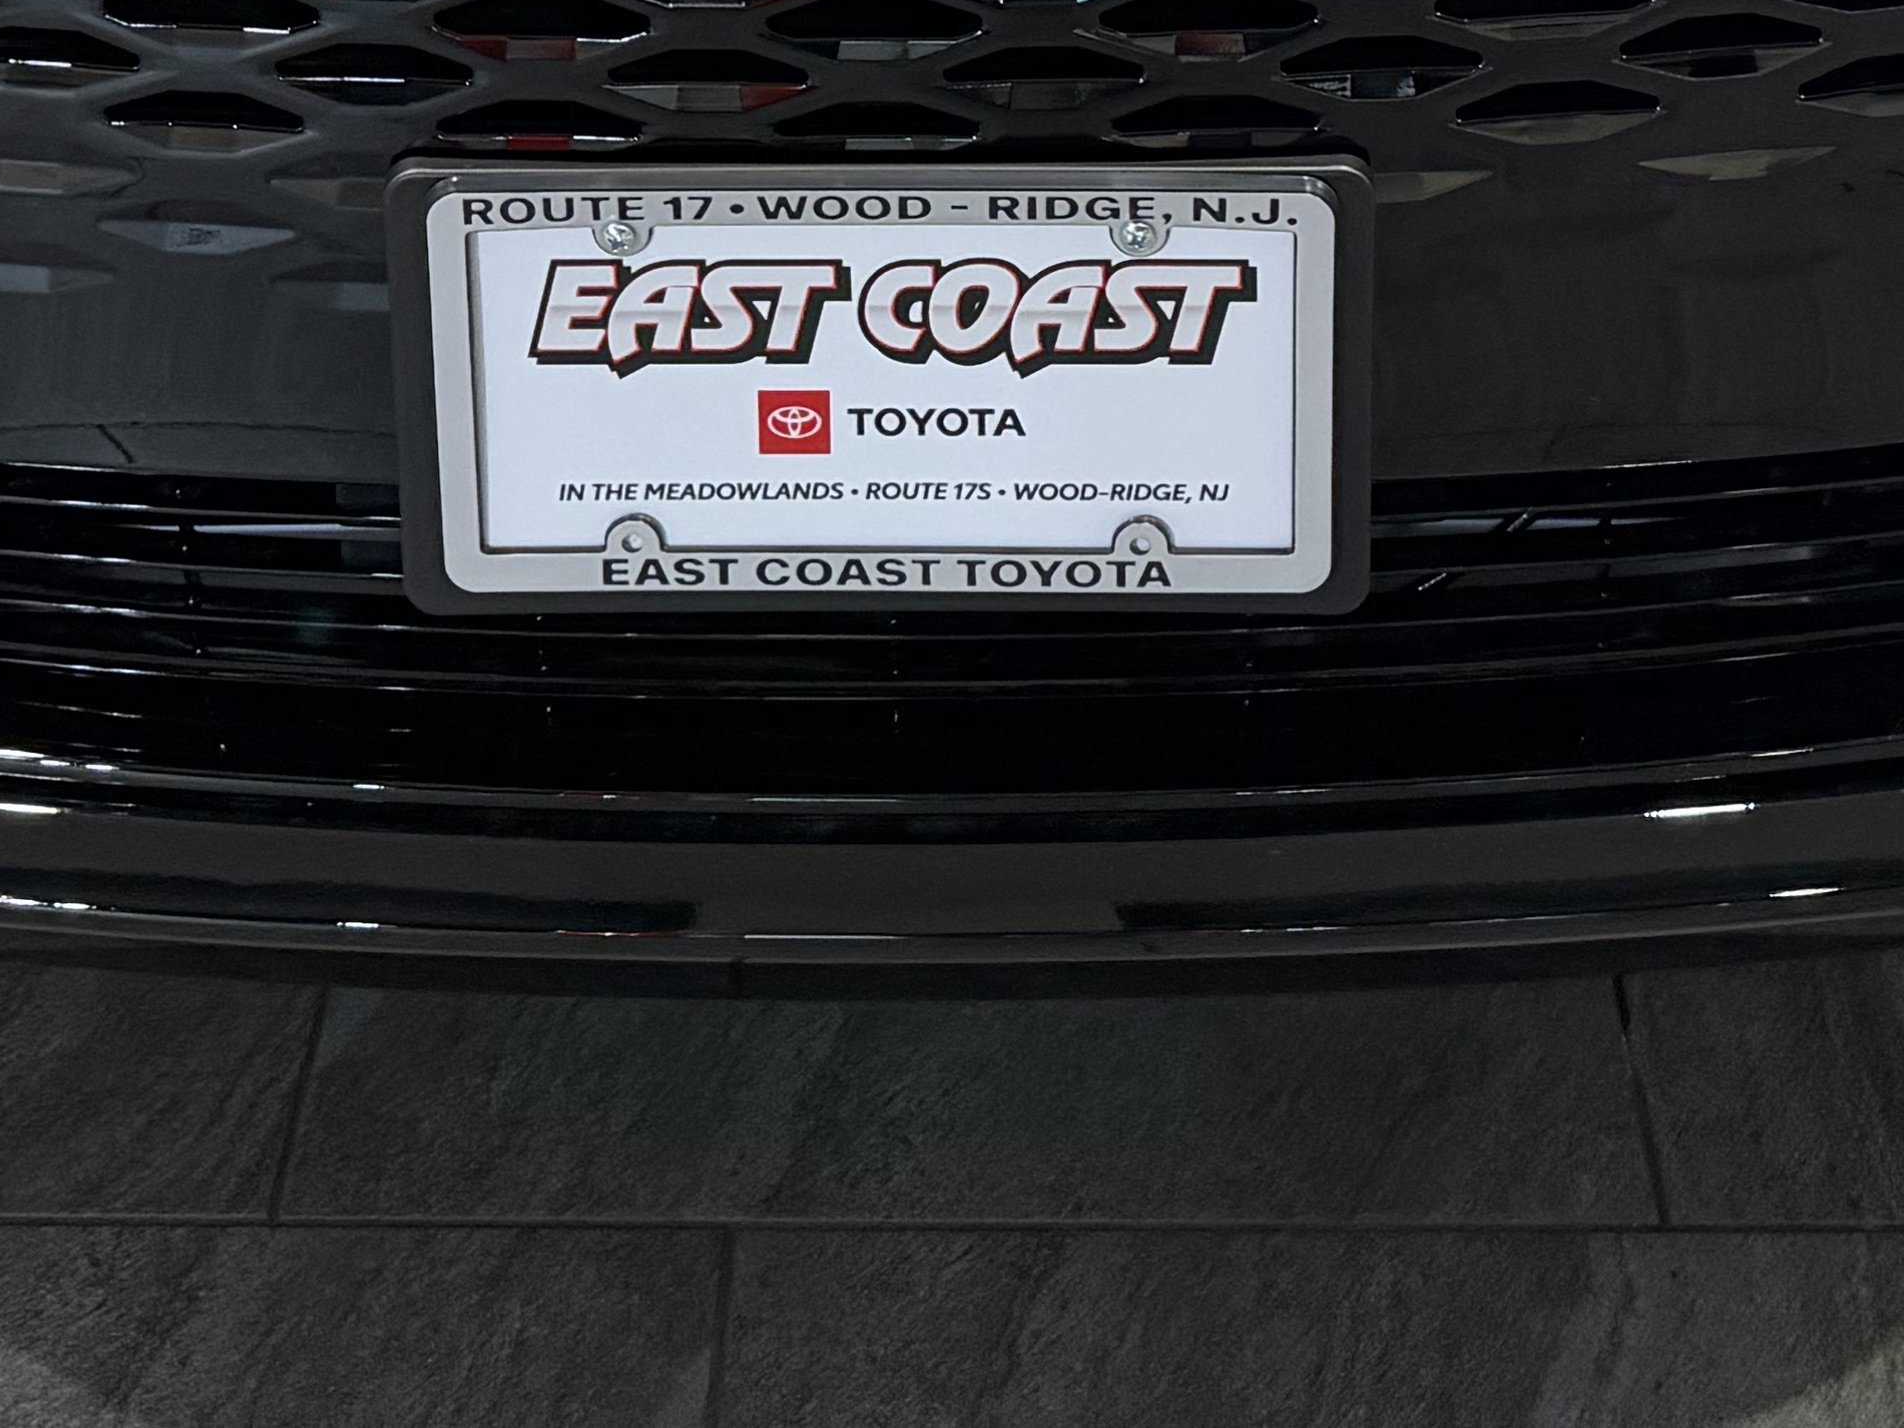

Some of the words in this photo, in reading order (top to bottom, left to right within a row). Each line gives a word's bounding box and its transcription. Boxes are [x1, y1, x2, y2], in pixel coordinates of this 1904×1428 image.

[463, 196, 645, 226] ROUTE
[663, 196, 713, 220] 17
[757, 195, 932, 221] WOOD
[988, 196, 1173, 226] RIDGE,
[1192, 197, 1299, 226] N.J.
[527, 259, 852, 380] EAST
[857, 257, 1257, 379] COAST
[847, 408, 1026, 437] TOYOTA
[559, 483, 585, 501] IN
[592, 483, 639, 501] THE
[643, 482, 844, 501] MEADOWLANDS
[866, 482, 948, 500] ROUTE
[953, 482, 992, 500] 17S
[1013, 483, 1193, 504] WOOD-RIDGE,
[1199, 483, 1230, 501] NJ
[601, 558, 740, 586] EAST
[755, 558, 941, 587] COAST
[957, 560, 1172, 588] TOYOTA
